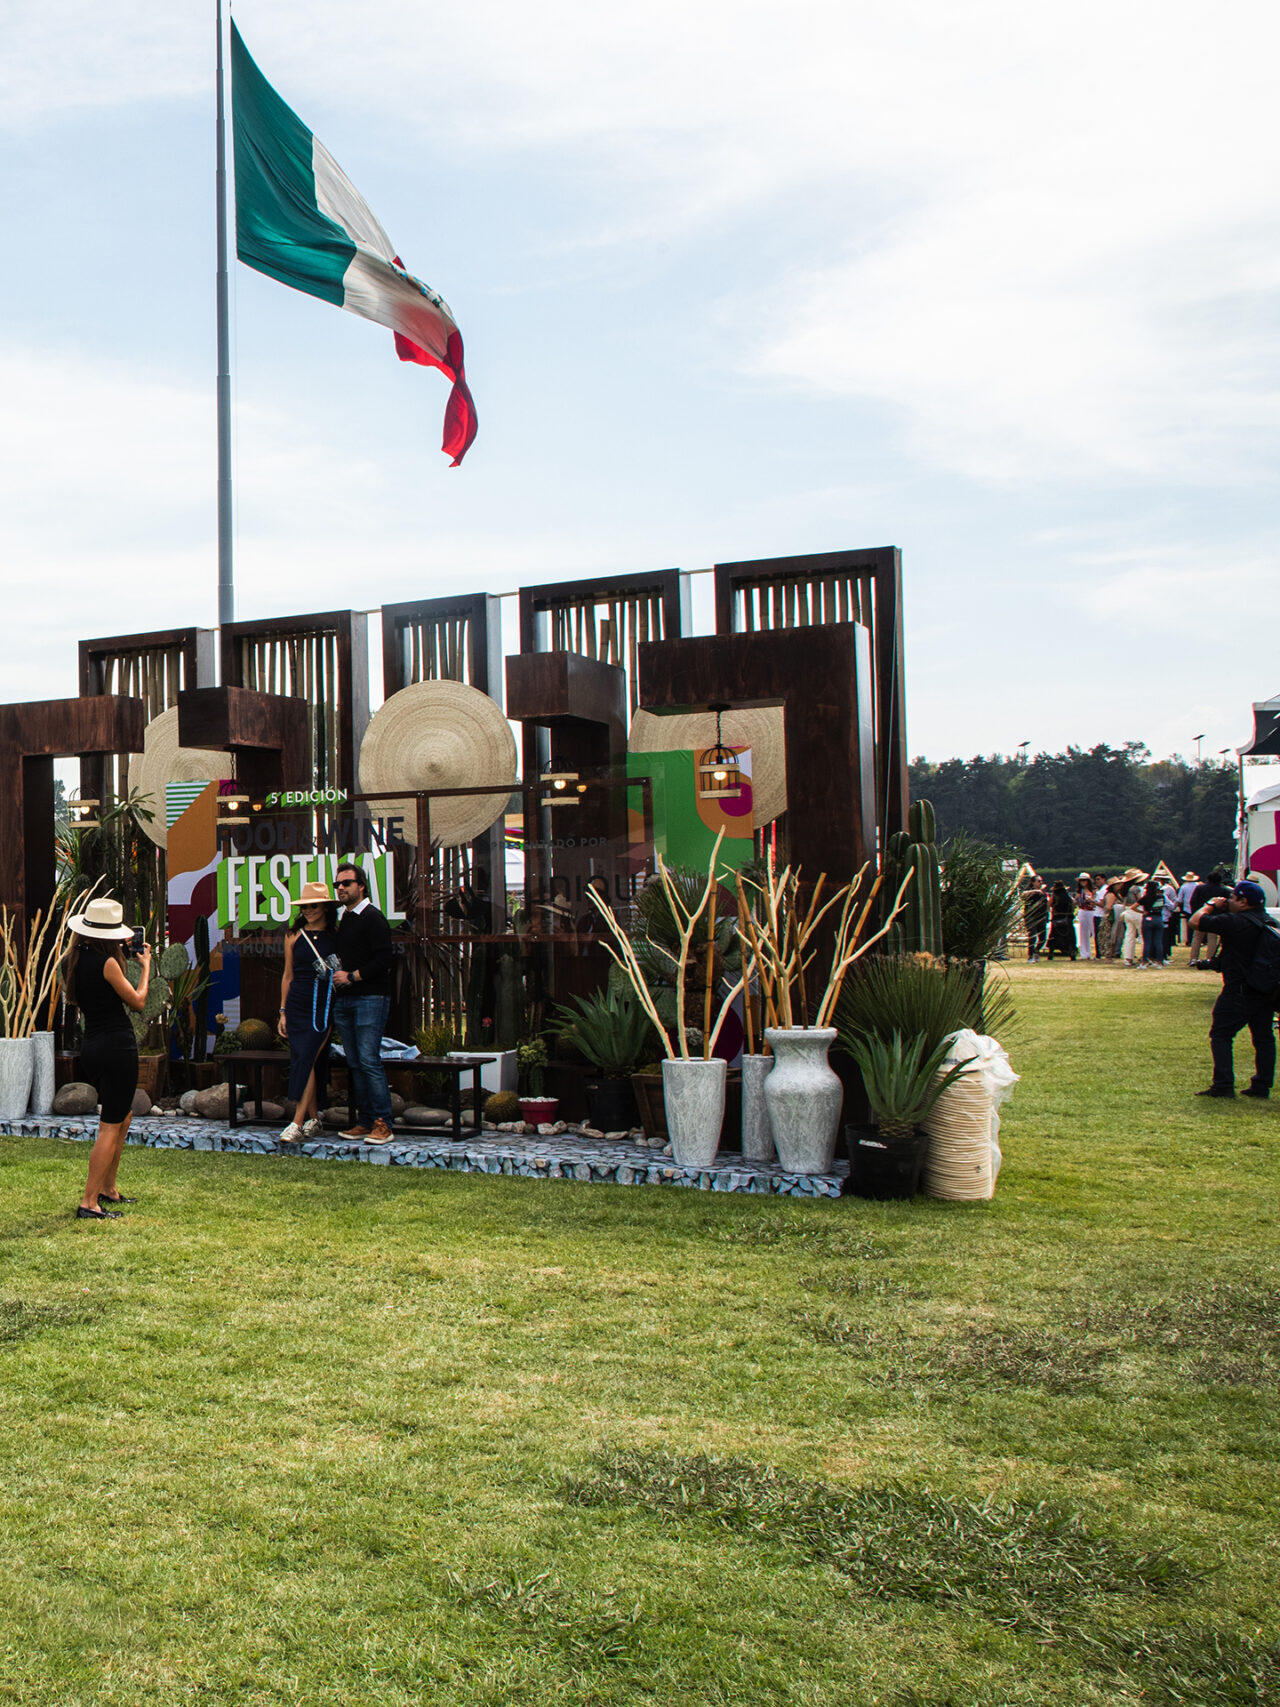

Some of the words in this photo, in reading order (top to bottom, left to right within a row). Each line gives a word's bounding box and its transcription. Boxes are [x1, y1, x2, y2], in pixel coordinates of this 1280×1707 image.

[284, 786, 348, 805] EDICIÓN
[216, 821, 297, 851] FOOD
[320, 816, 405, 848] WINE
[580, 836, 608, 848] POR
